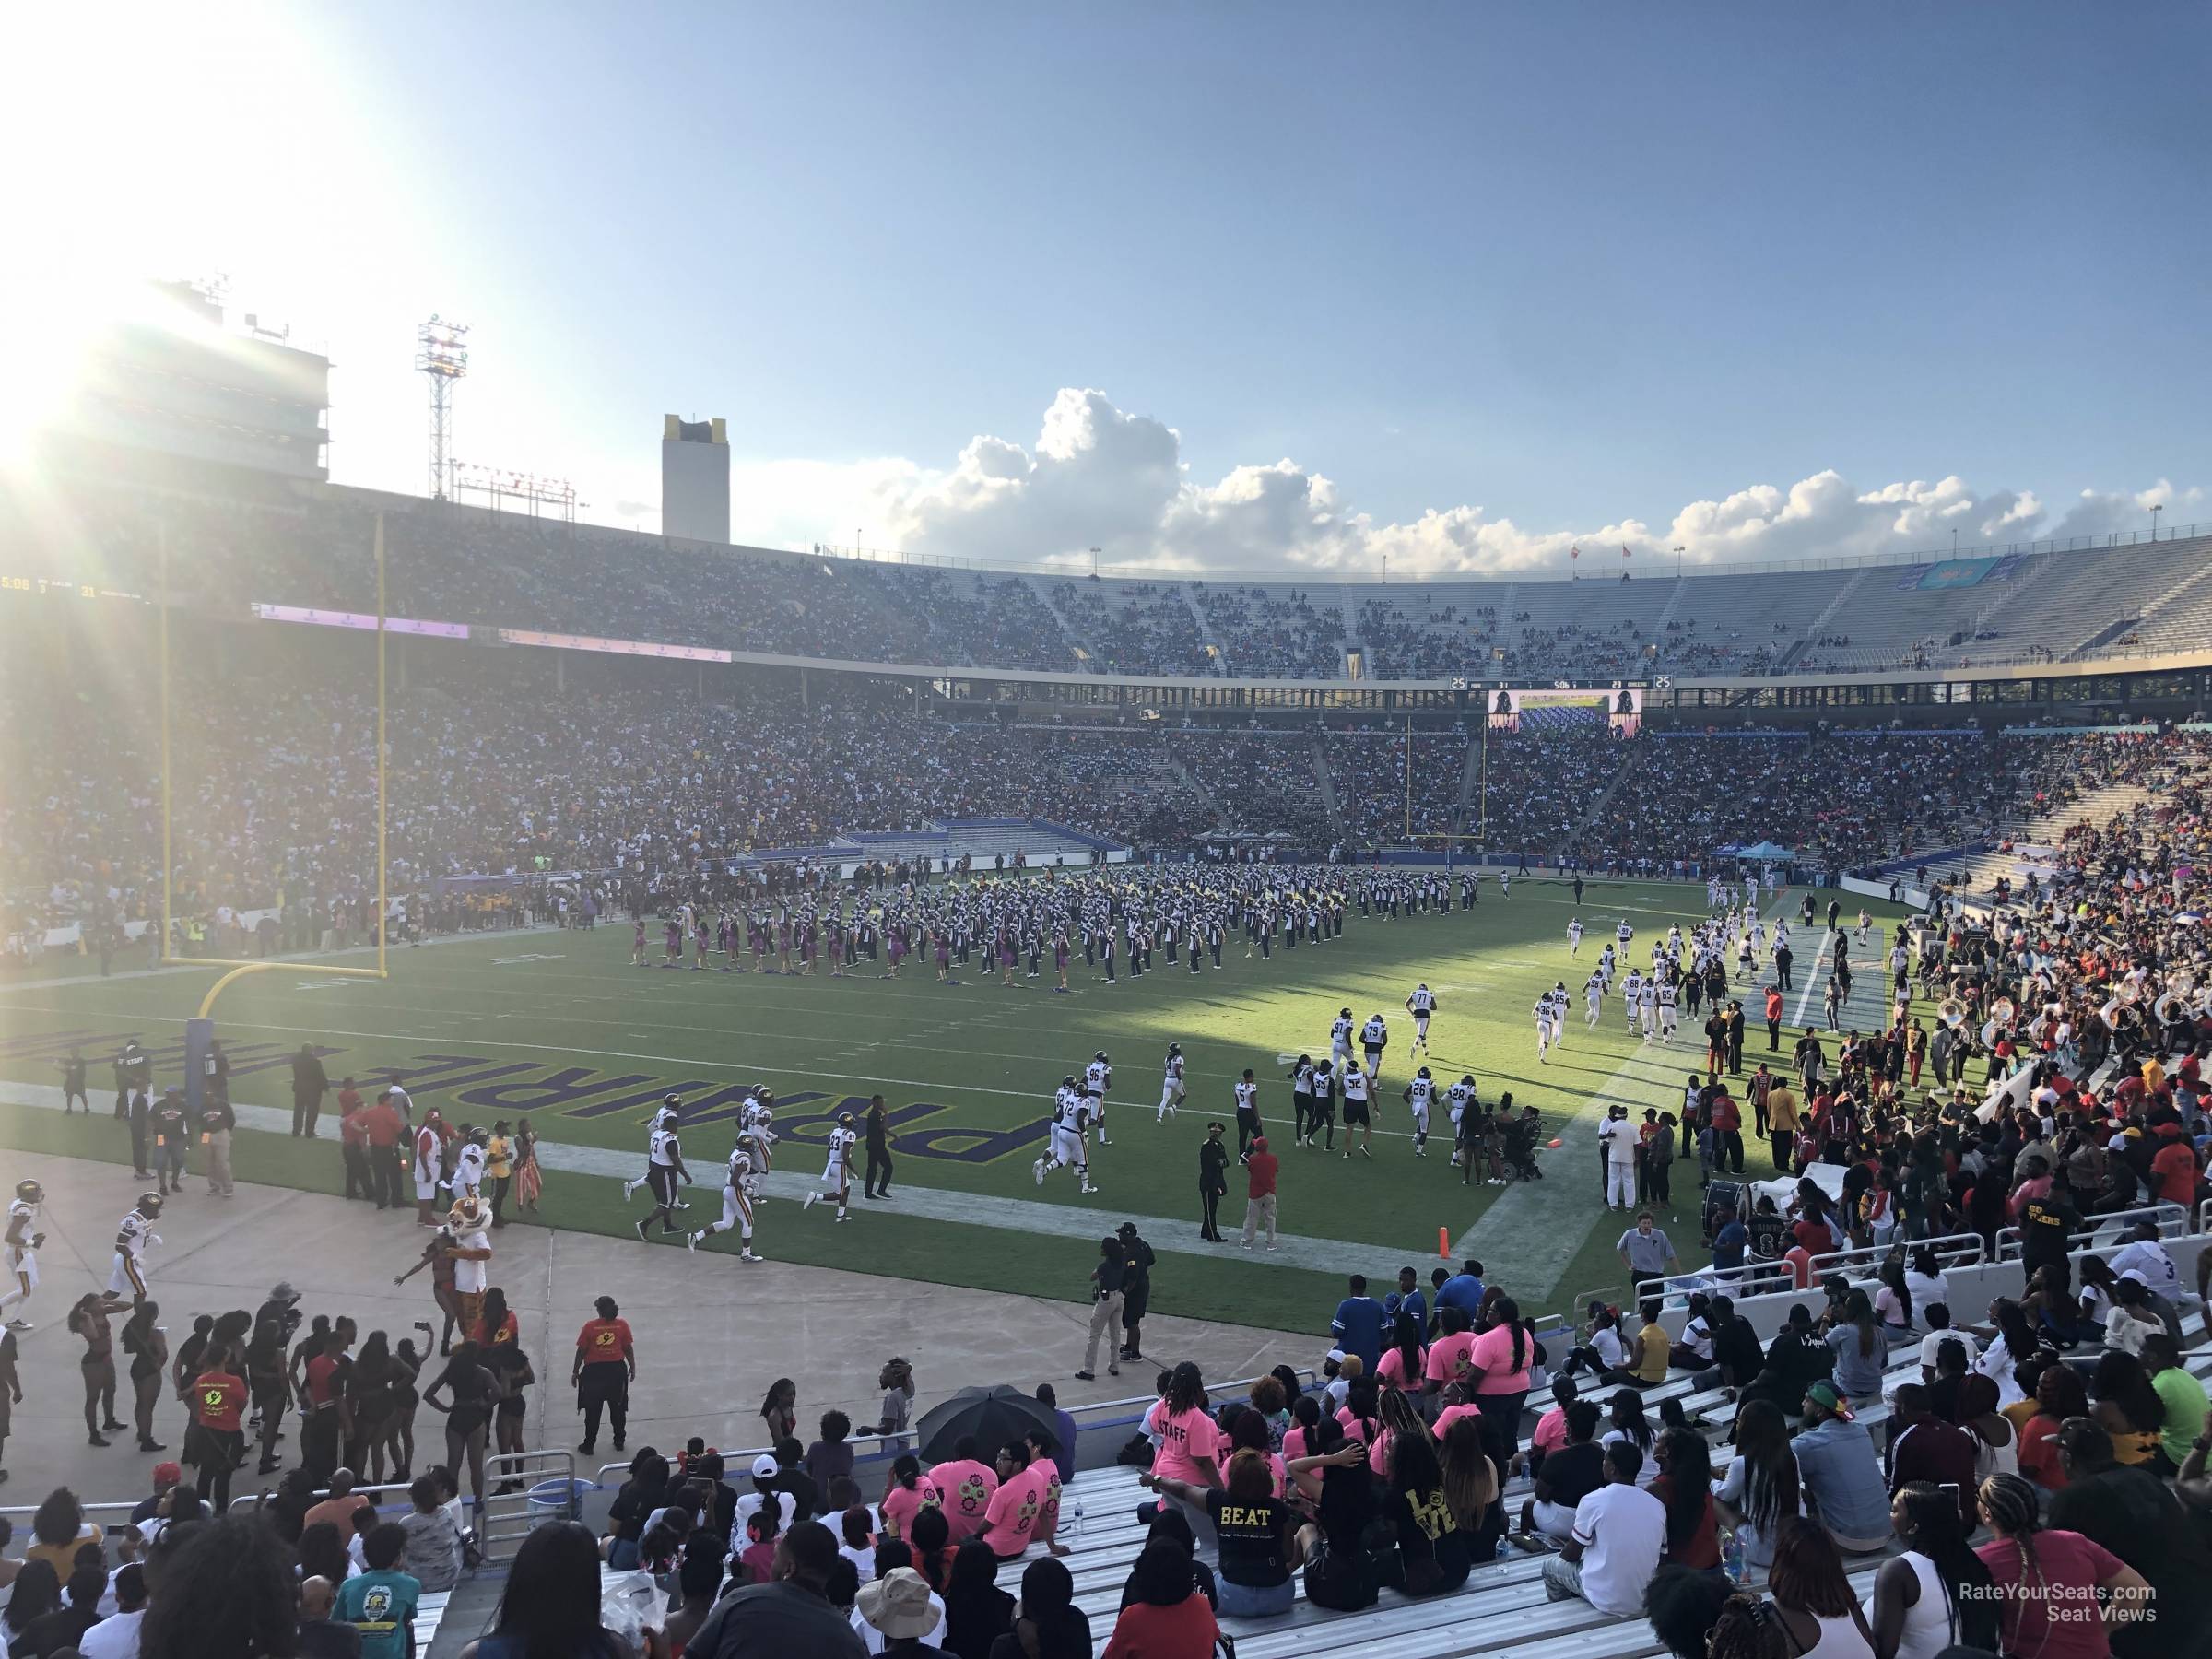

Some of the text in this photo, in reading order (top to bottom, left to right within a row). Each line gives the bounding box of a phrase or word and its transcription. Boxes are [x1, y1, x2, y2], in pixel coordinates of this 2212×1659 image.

[81, 585, 96, 598] 31
[1451, 677, 1465, 688] 25
[1499, 681, 1508, 689] 31
[1611, 680, 1622, 688] 23
[1655, 677, 1670, 688] 25
[1630, 979, 1640, 989] 68
[1418, 993, 1428, 1004] 77
[1555, 994, 1565, 1005] 85
[1662, 990, 1672, 1000] 65
[1541, 1006, 1550, 1016] 36
[1368, 1026, 1379, 1037] 79
[1089, 1067, 1100, 1082] 96
[1413, 1082, 1426, 1097] 26
[1453, 1088, 1465, 1101] 28
[1239, 1089, 1245, 1102] 6
[1064, 1100, 1076, 1117] 72
[2029, 1205, 2043, 1214] GO
[2164, 1260, 2175, 1280] 3
[1159, 1419, 1186, 1444] STAFF
[1220, 1506, 1272, 1526] BEAT
